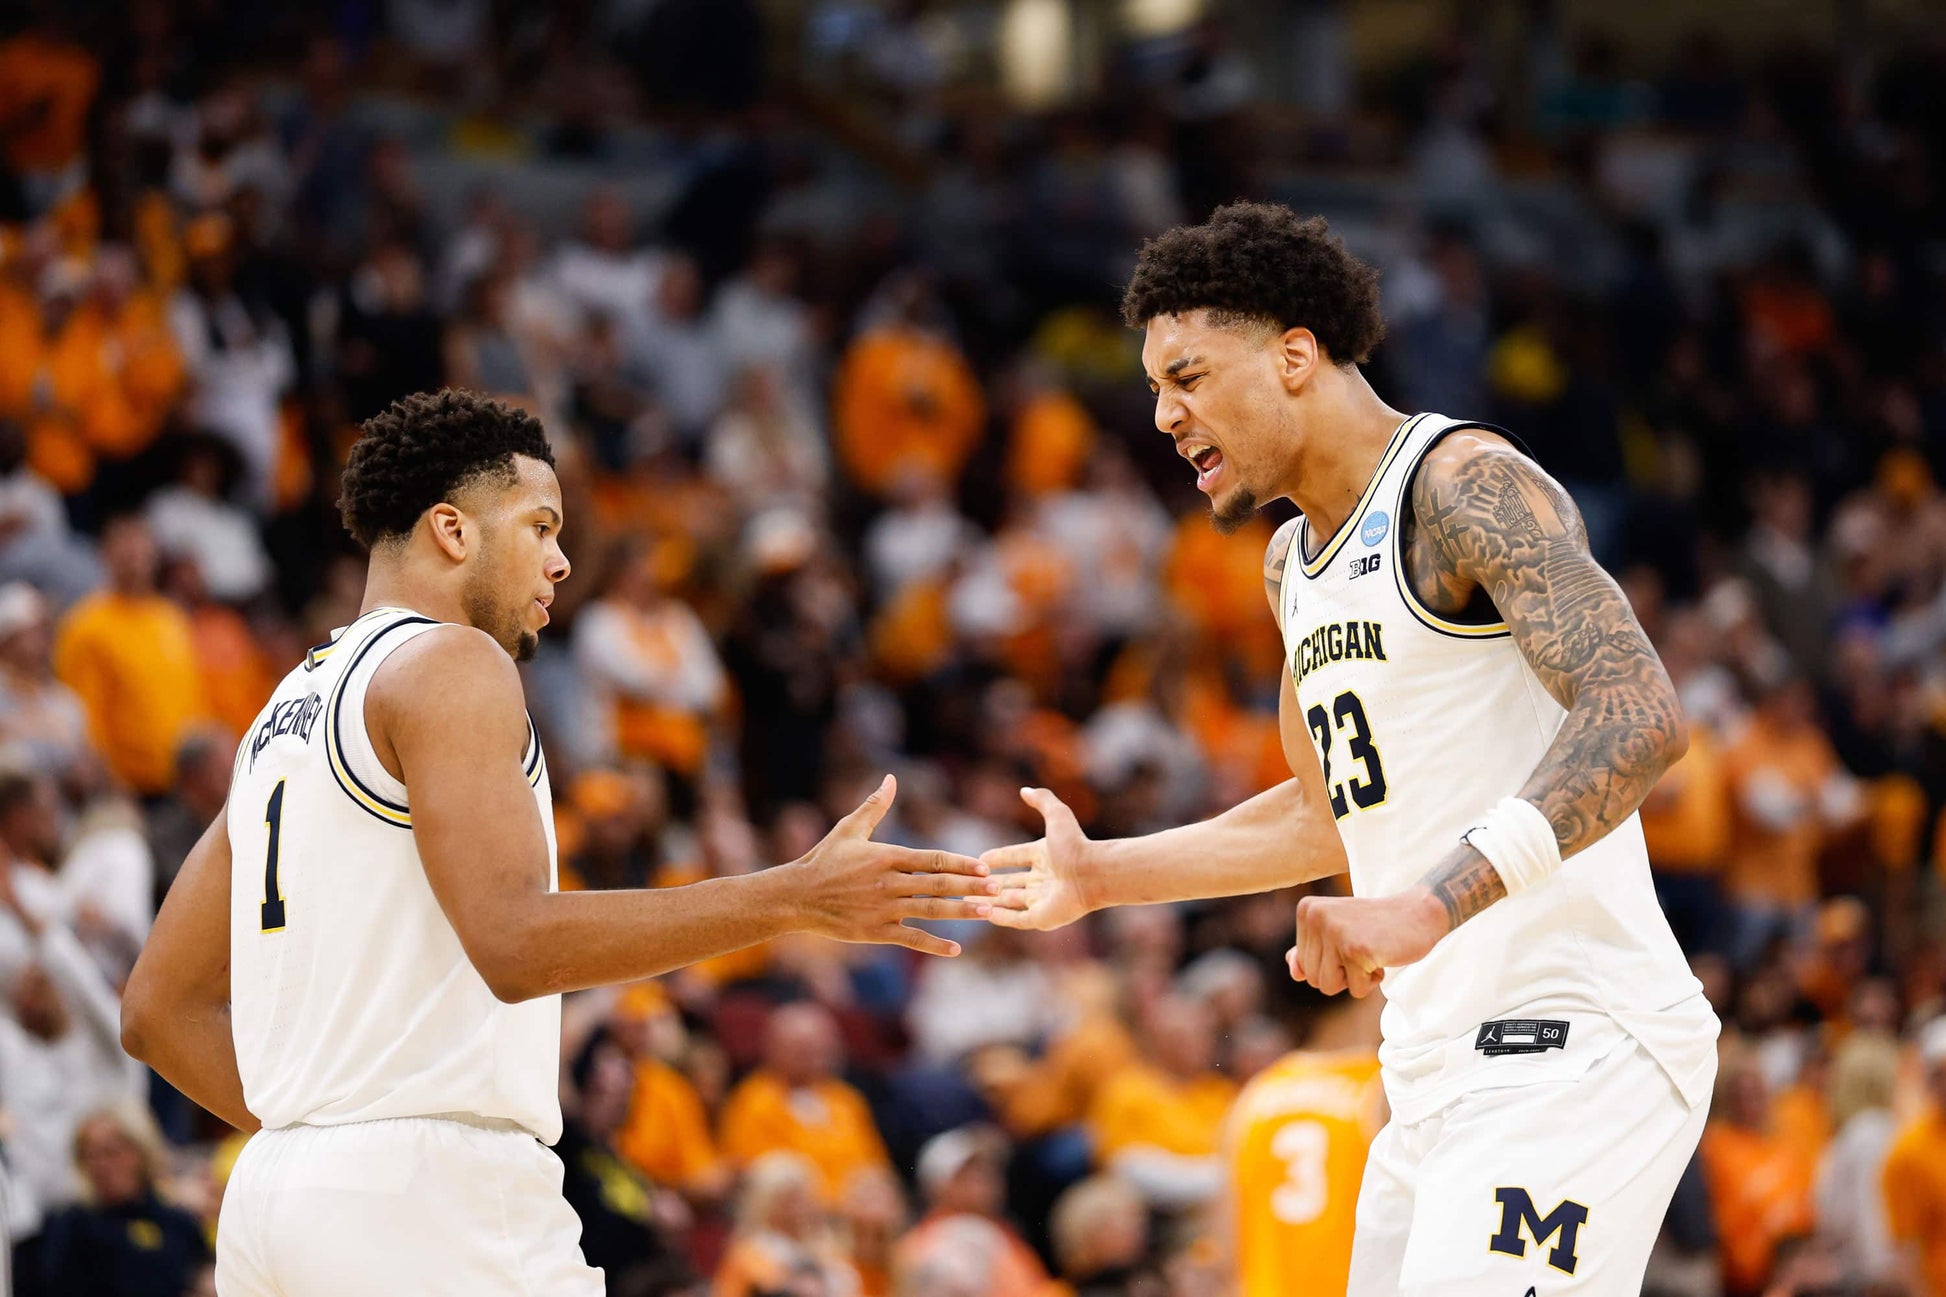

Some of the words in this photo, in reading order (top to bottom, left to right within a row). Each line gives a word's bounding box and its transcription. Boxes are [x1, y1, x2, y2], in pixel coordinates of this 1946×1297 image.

[1307, 688, 1389, 820] 23
[260, 776, 287, 934] 1
[1542, 1027, 1560, 1039] 50
[1271, 1120, 1328, 1224] 3
[1487, 1184, 1591, 1278] M
